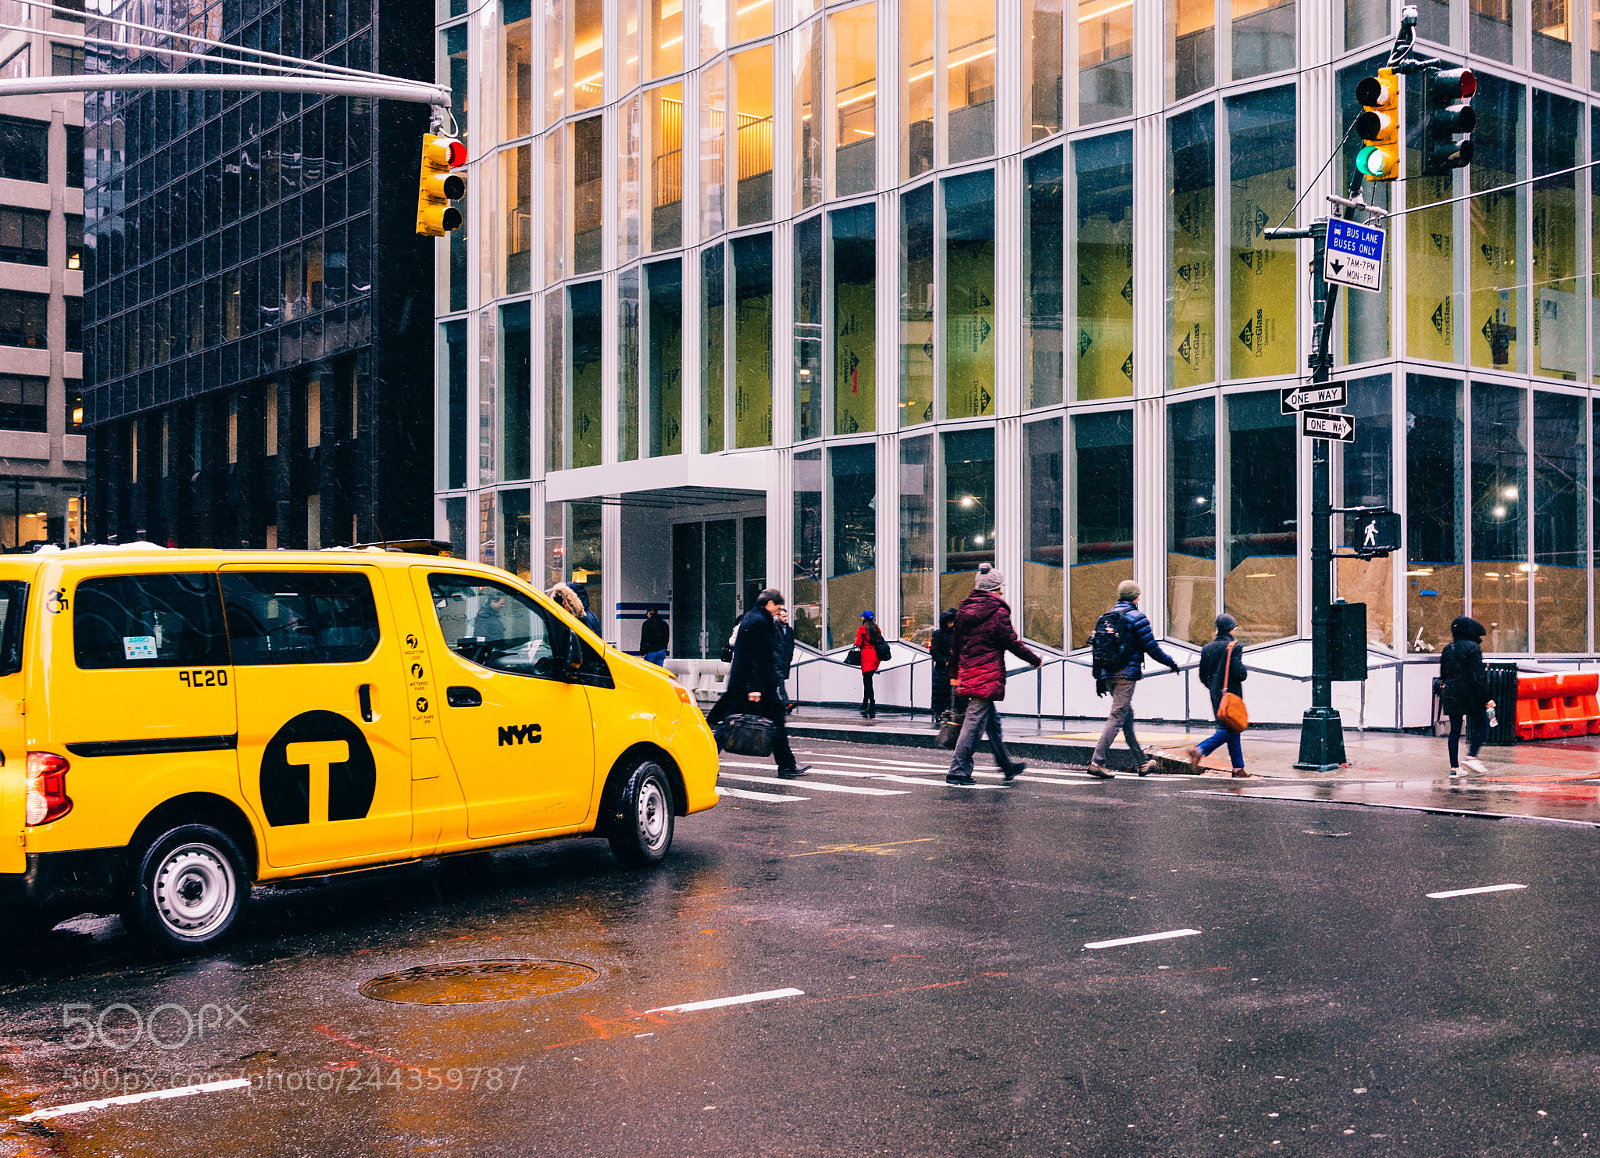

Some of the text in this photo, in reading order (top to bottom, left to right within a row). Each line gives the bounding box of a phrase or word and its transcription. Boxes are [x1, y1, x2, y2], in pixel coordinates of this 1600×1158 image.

[1346, 227, 1379, 244] BUS LANE
[1333, 237, 1376, 257] BUSES ONLY
[1346, 257, 1376, 271] 7AM-7PM
[1346, 270, 1374, 284] MON-FRI
[1255, 308, 1263, 358] DensGlass
[1193, 323, 1201, 371] DensGlass
[1291, 389, 1338, 405] ONE WAY
[1310, 419, 1347, 433] ONE WAY
[179, 669, 228, 688] 9C20
[498, 723, 542, 747] NYC
[285, 739, 350, 824] T
